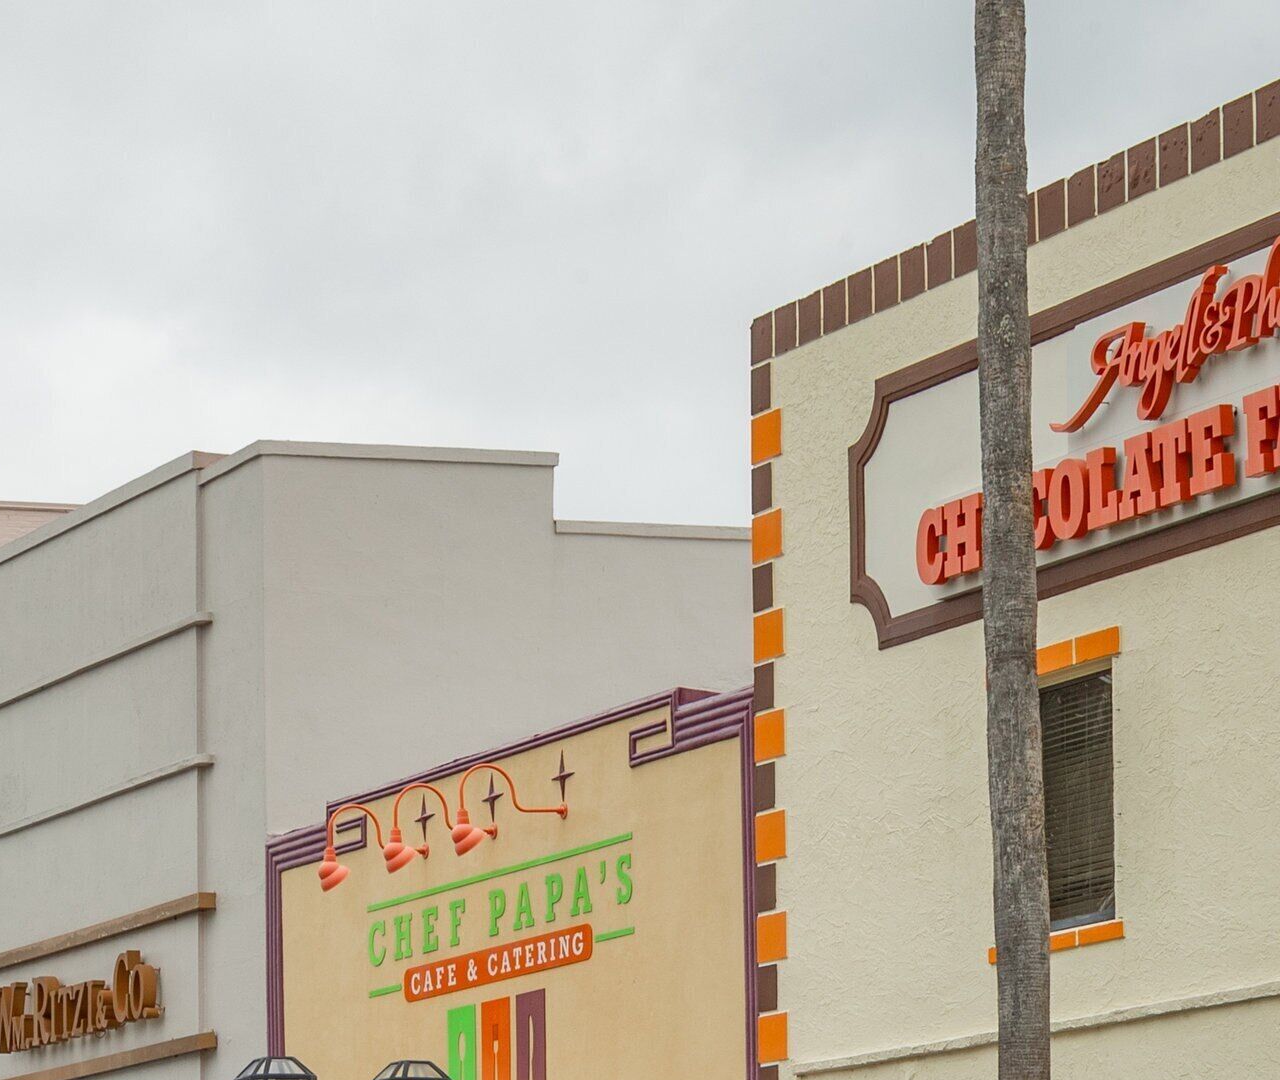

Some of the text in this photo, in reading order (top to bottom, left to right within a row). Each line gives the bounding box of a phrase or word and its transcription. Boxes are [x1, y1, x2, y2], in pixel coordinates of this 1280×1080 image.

[1220, 236, 1280, 352] Ph
[1243, 385, 1280, 478] F
[366, 852, 634, 968] CHEF PAPA'S
[409, 931, 586, 996] CAFE & CATERING
